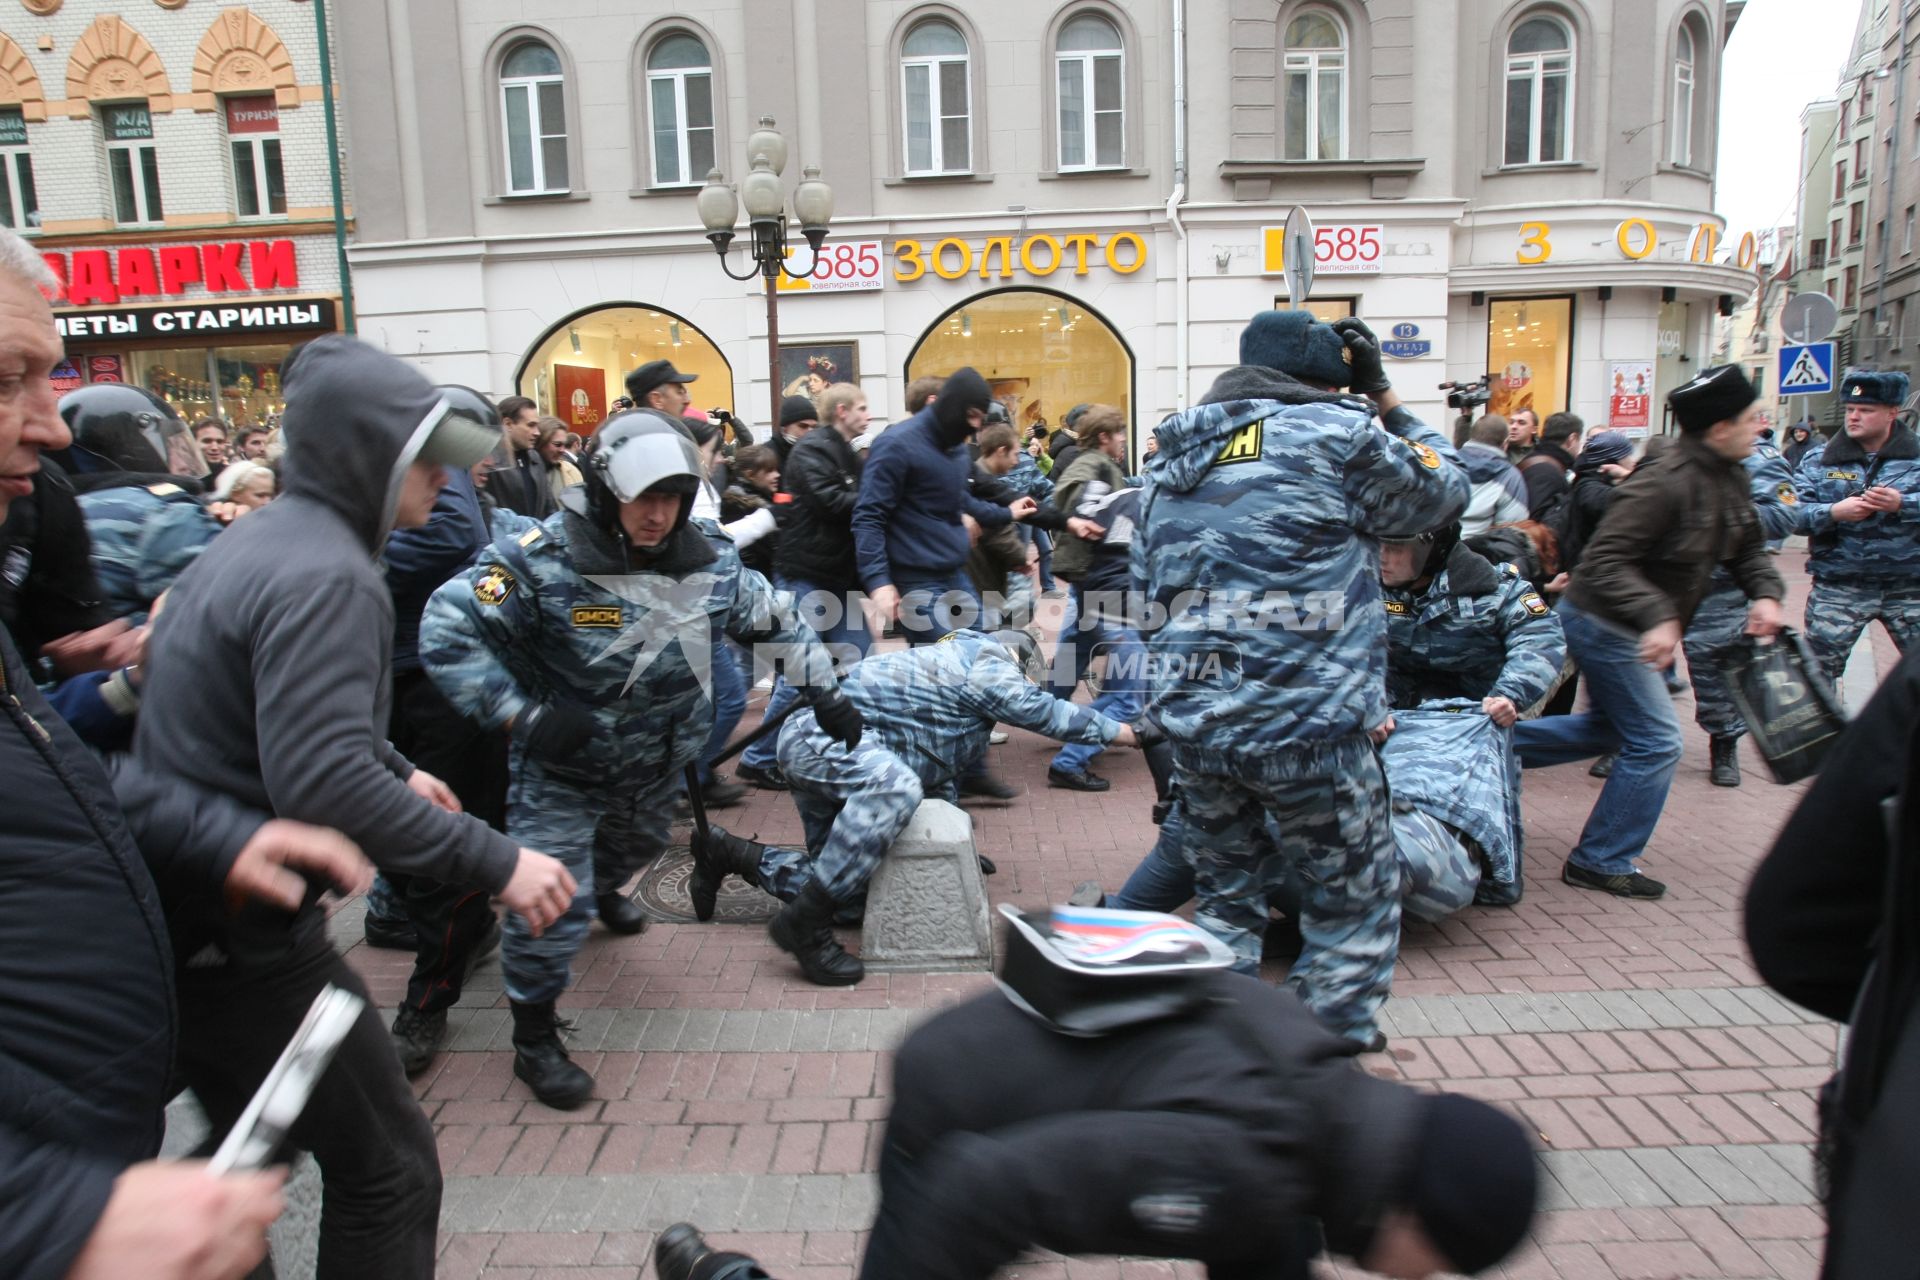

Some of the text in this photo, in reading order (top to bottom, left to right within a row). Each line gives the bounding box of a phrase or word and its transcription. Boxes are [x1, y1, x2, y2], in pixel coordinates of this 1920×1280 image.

[115, 111, 149, 127] Ж/Д
[233, 110, 278, 122] ТУРИЗМ
[115, 128, 152, 138] БИЛЕТЫ
[1314, 227, 1380, 262] 585
[812, 243, 880, 280] 585
[892, 231, 1148, 282] ЗОЛОТО
[1361, 263, 1380, 271] сеть
[812, 280, 881, 290] ювелирная сеть
[152, 304, 321, 332] СТАРИНЫ
[1400, 325, 1413, 338] 13
[1387, 343, 1425, 352] АРБАТ
[1619, 396, 1641, 409] 2=1
[575, 610, 619, 624] ОМОН
